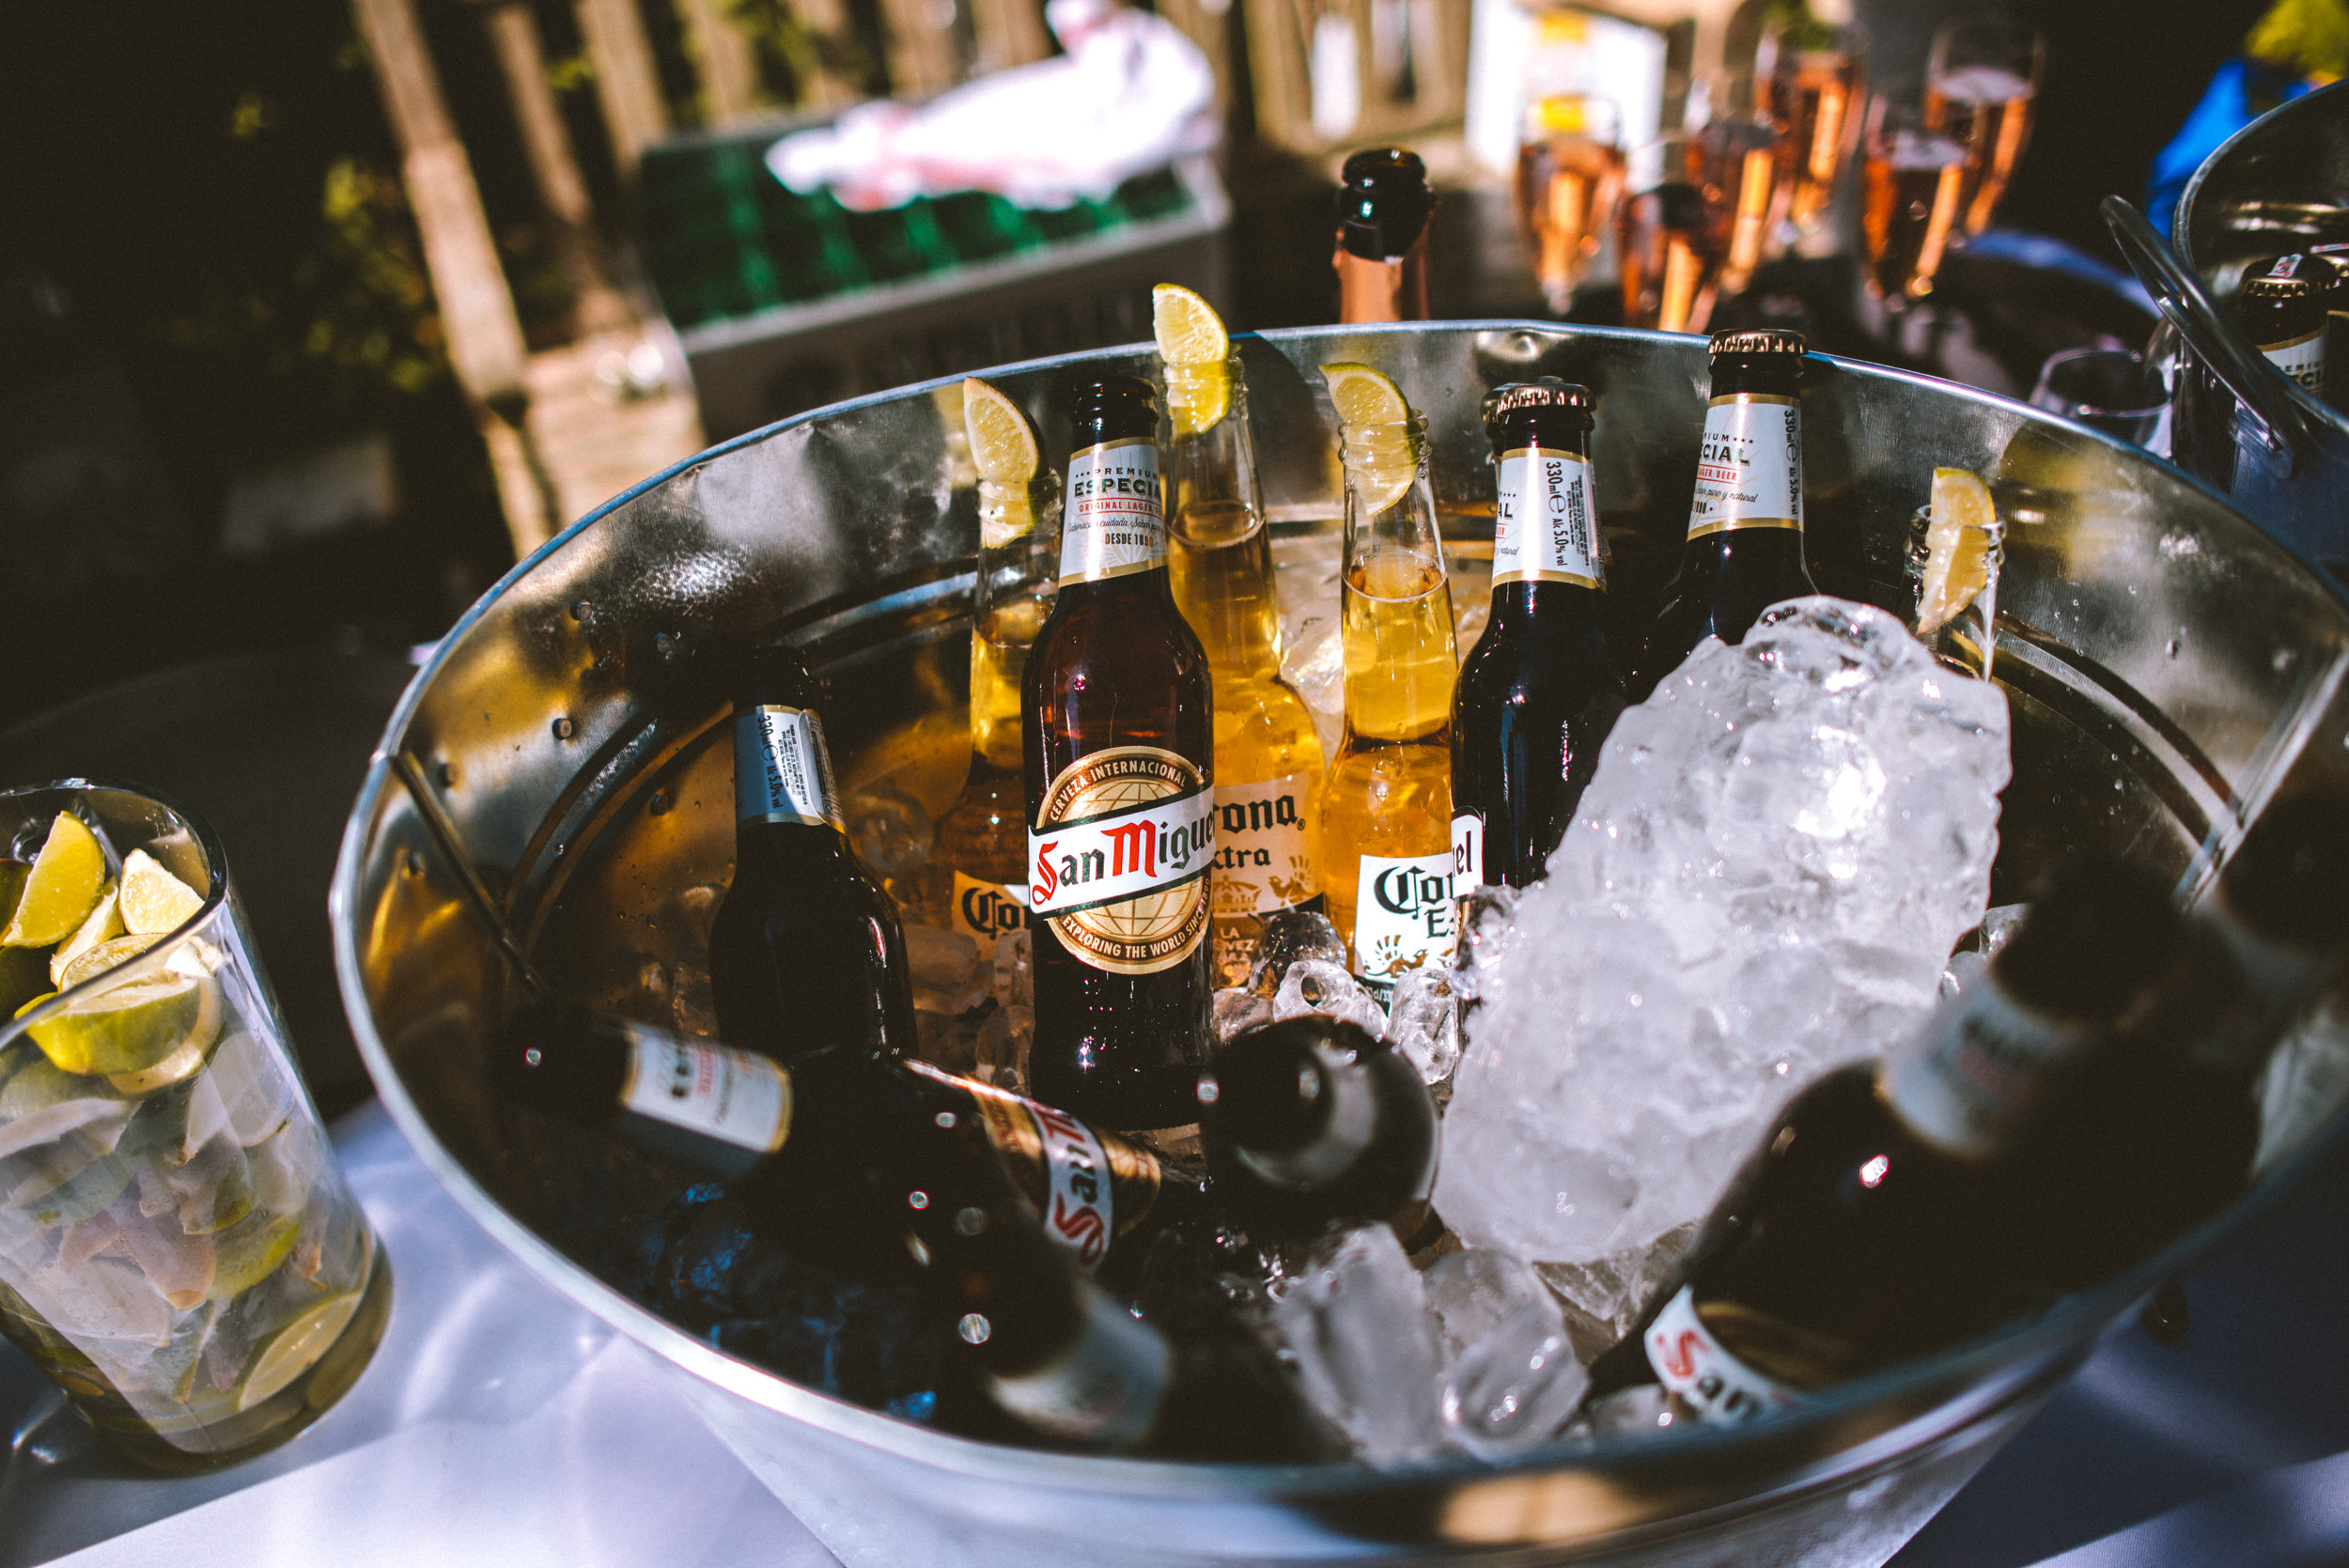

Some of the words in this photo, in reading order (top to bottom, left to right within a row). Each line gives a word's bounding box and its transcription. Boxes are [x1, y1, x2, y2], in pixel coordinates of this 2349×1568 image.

[1716, 470, 1737, 481] BEER
[1729, 492, 1759, 504] natural
[1128, 502, 1153, 513] LAGER
[1552, 519, 1563, 529] Alc
[1105, 533, 1132, 546] DESDE
[1134, 533, 1154, 548] 1890
[1553, 531, 1569, 553] 5.0%
[1556, 555, 1568, 566] vol
[1050, 774, 1088, 821] CERVEZA
[1090, 760, 1189, 787] INTERNACIONAL
[1032, 840, 1105, 906] San
[1100, 811, 1214, 877] Migue
[1062, 915, 1122, 956] EXPLORING
[1125, 945, 1146, 957] THE
[1149, 932, 1186, 956] WORLD
[1185, 905, 1205, 936] SINCE
